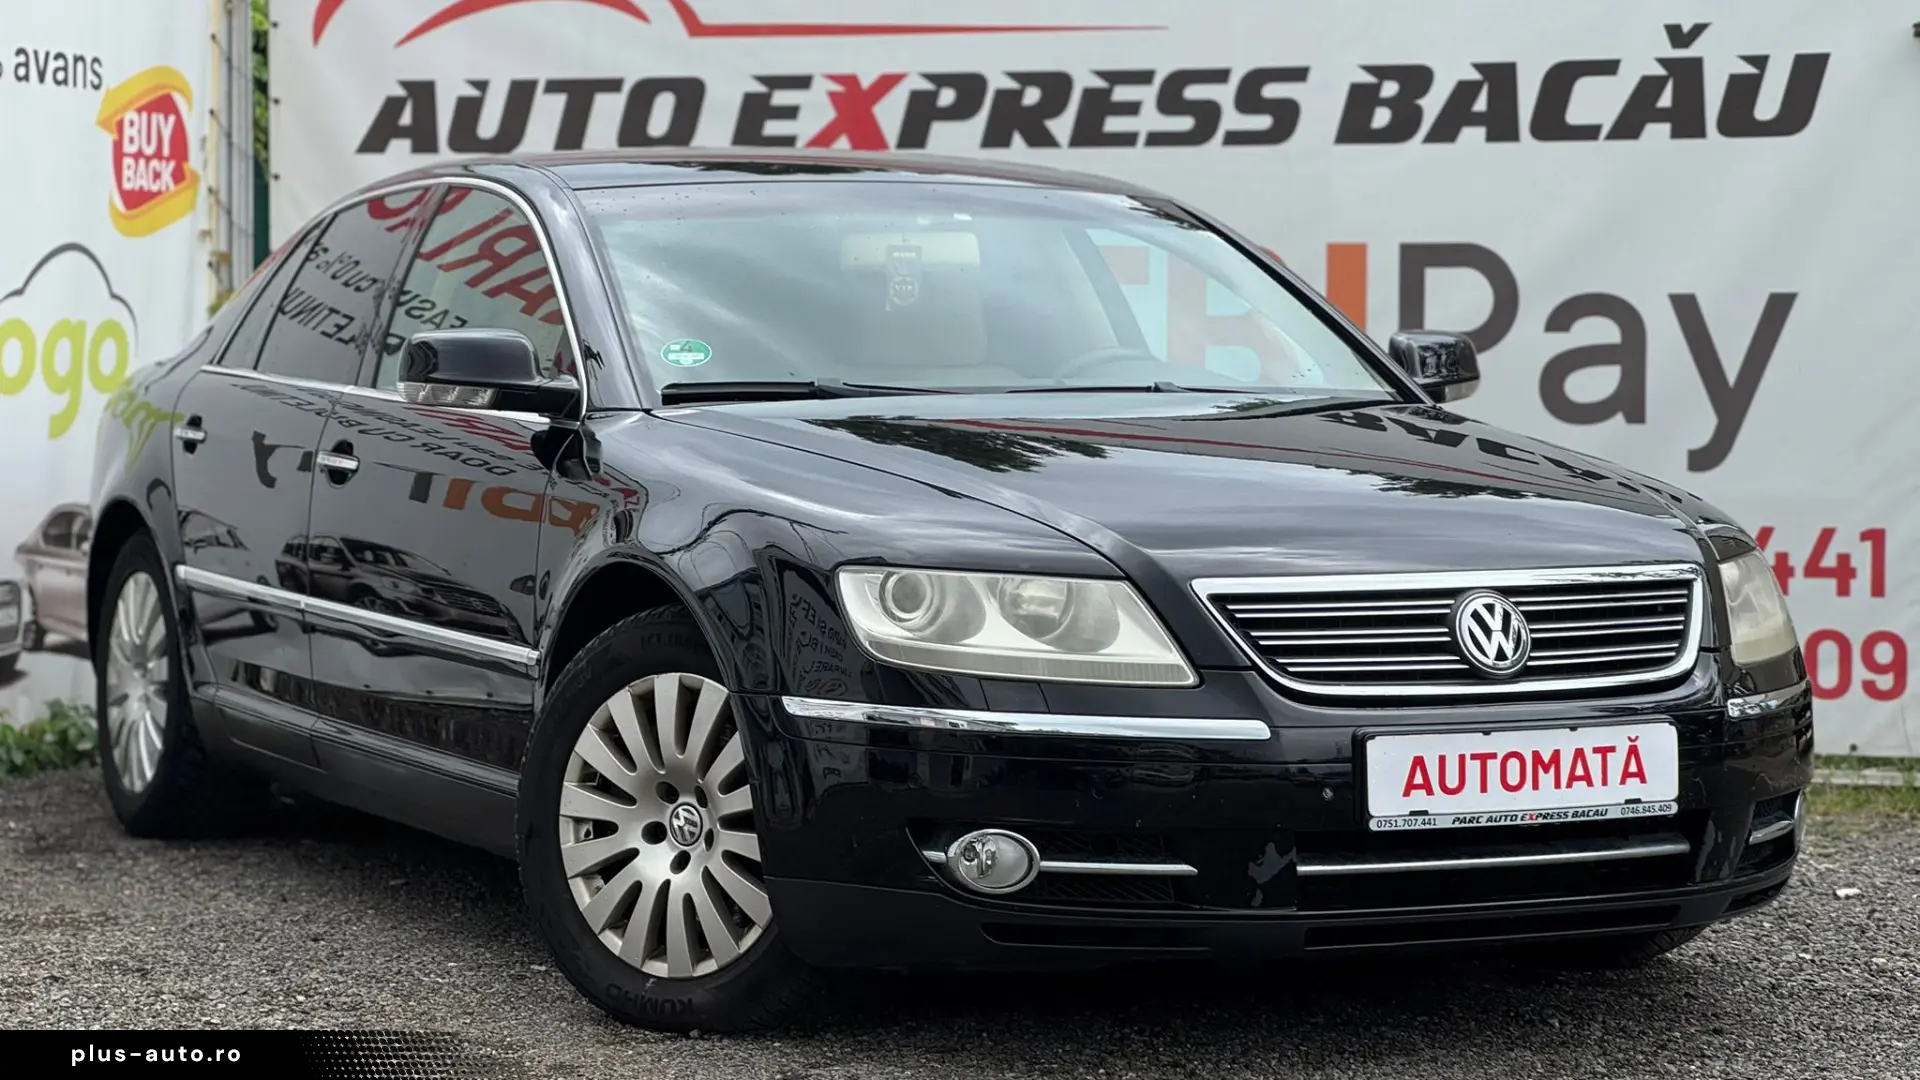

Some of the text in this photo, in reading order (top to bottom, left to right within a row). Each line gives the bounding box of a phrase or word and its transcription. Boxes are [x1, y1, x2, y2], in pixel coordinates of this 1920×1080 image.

[14, 46, 103, 91] avans
[355, 22, 1832, 155] AUTO EXPRESS BACĂU
[122, 110, 177, 158] BUY
[122, 156, 176, 193] BACK
[0, 317, 130, 440] ogo
[1402, 735, 1648, 798] AUTOMATĂ
[1376, 818, 1437, 829] 0751.707.441
[1451, 814, 1482, 826] PARC
[1484, 812, 1519, 824] AUTO
[1520, 810, 1570, 823] EXPRESS
